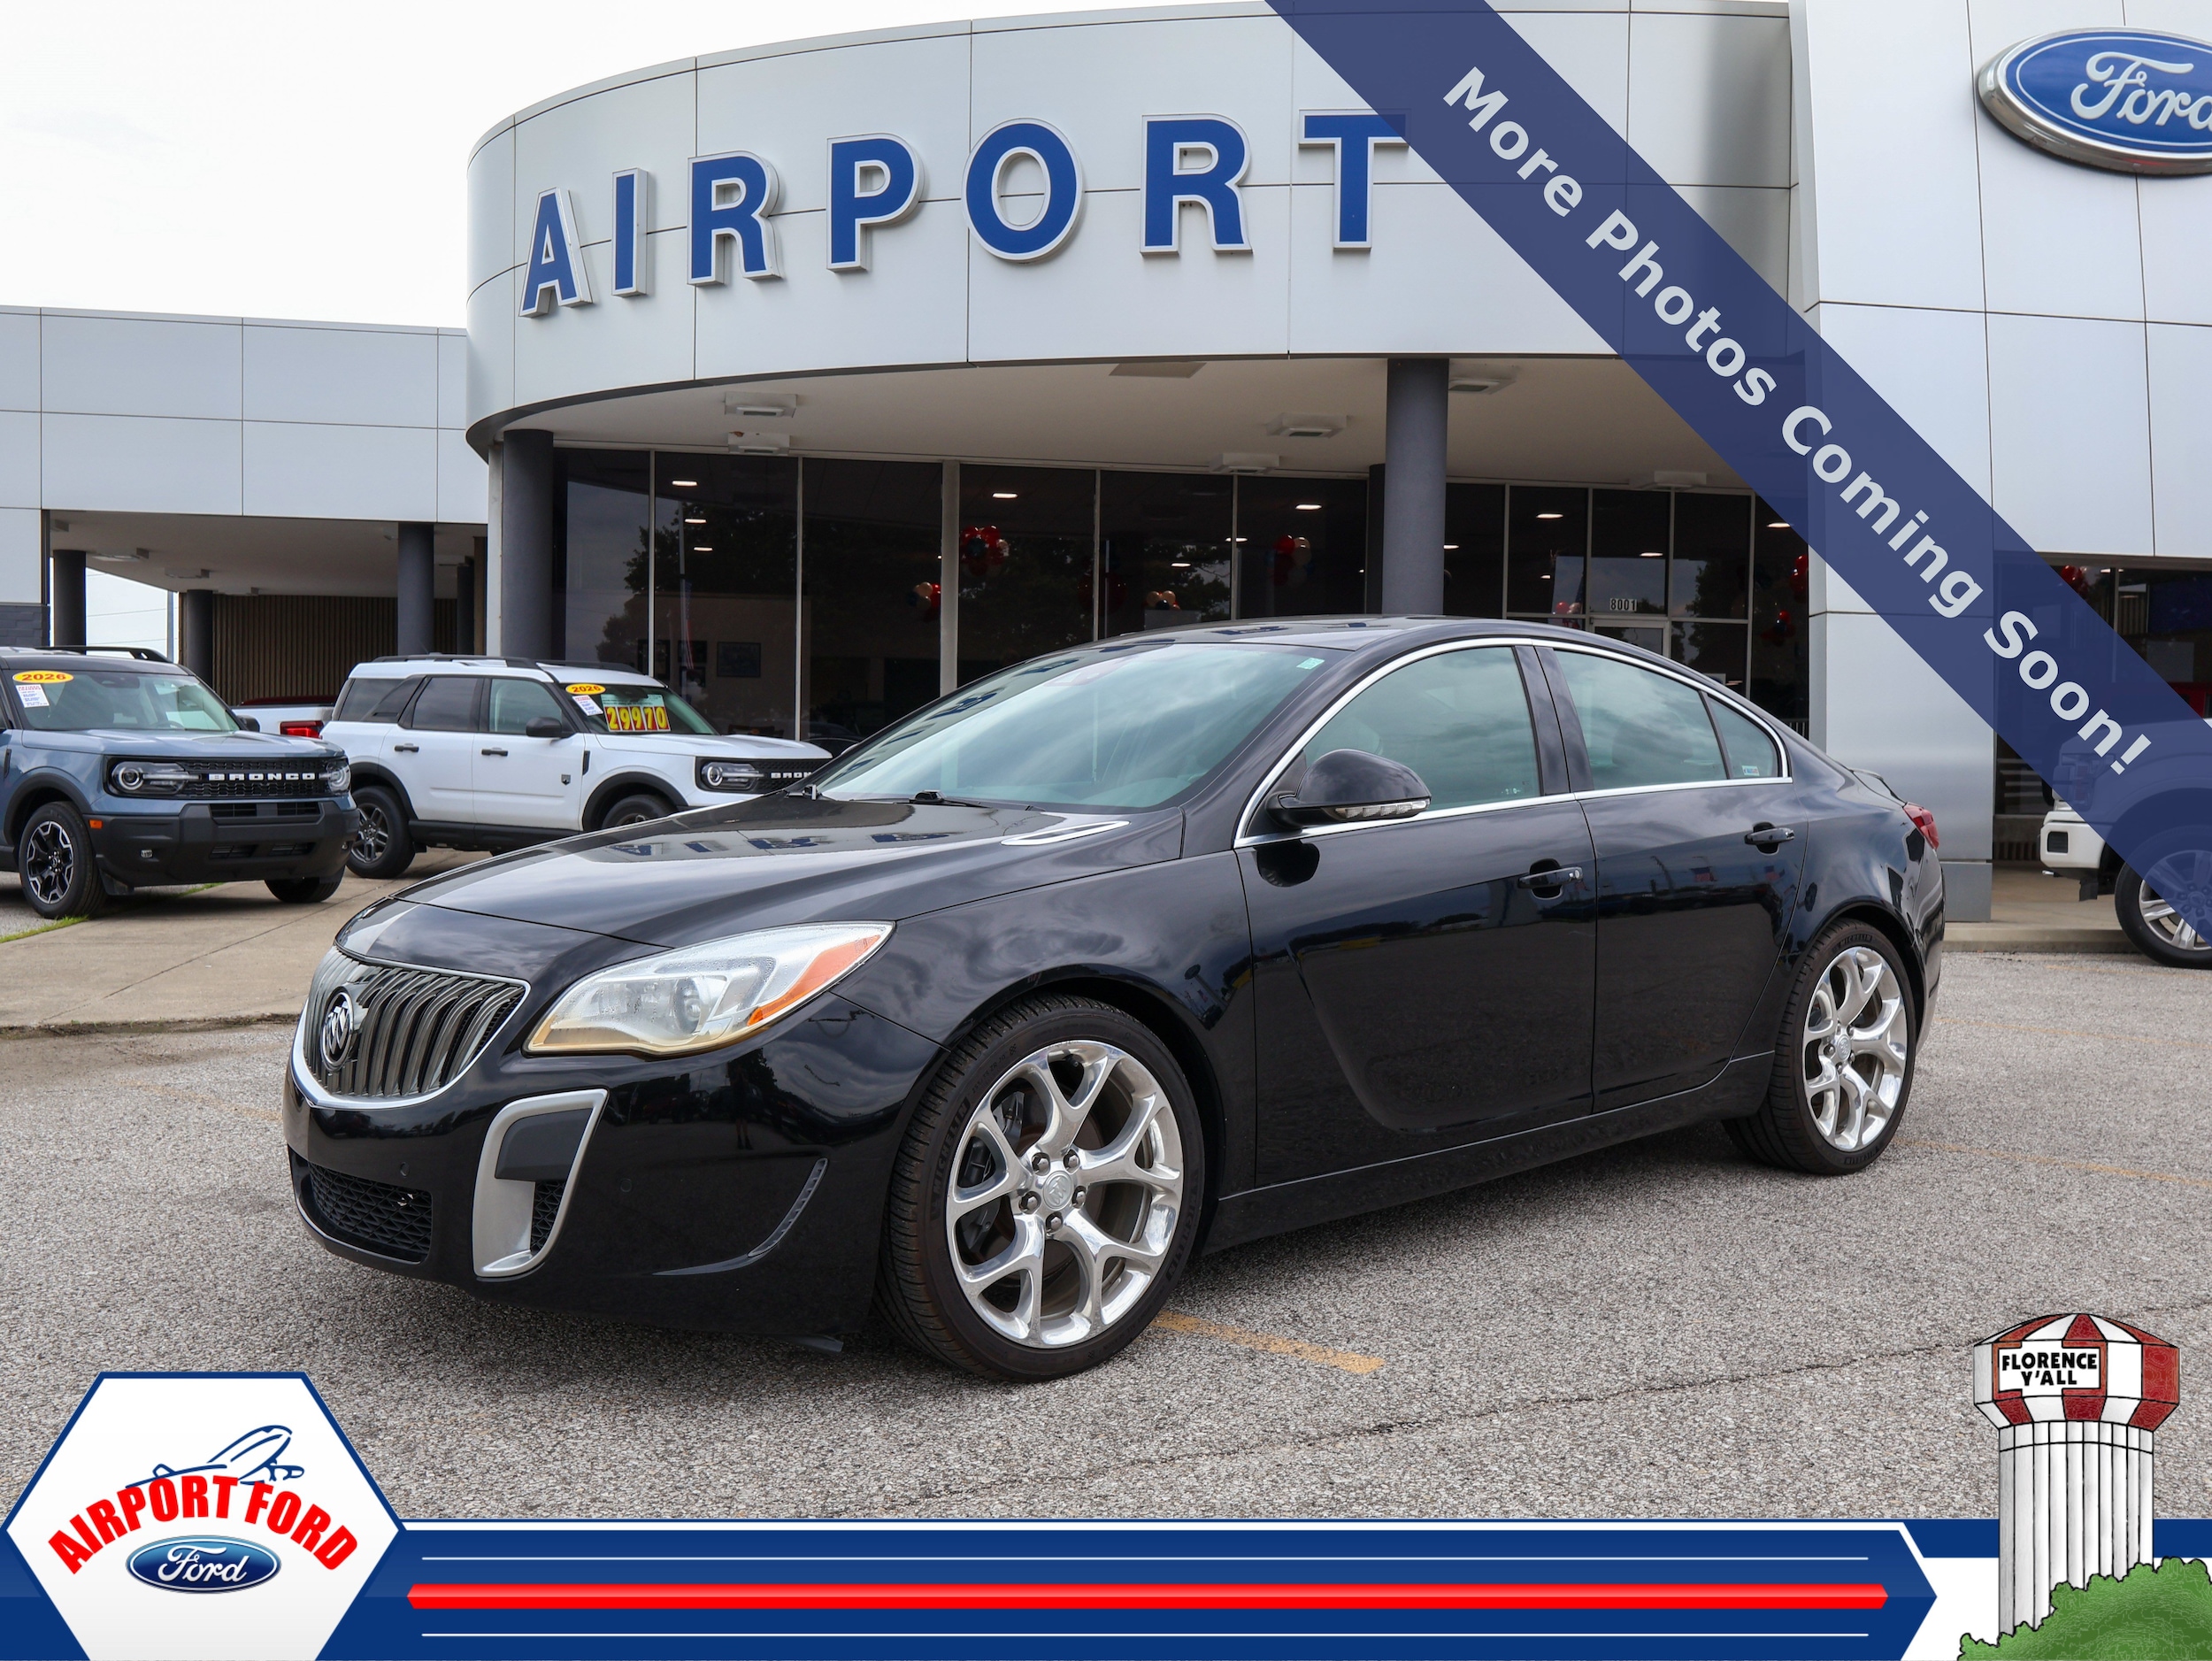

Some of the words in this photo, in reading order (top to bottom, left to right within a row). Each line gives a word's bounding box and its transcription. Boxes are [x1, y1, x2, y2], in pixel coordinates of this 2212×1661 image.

[518, 108, 1409, 317] AIRPORT
[1610, 598, 1635, 611] 8001
[572, 684, 602, 693] 2026
[606, 706, 668, 731] 29970
[208, 773, 316, 781] BRONCO
[932, 1101, 971, 1194] MICHELIN
